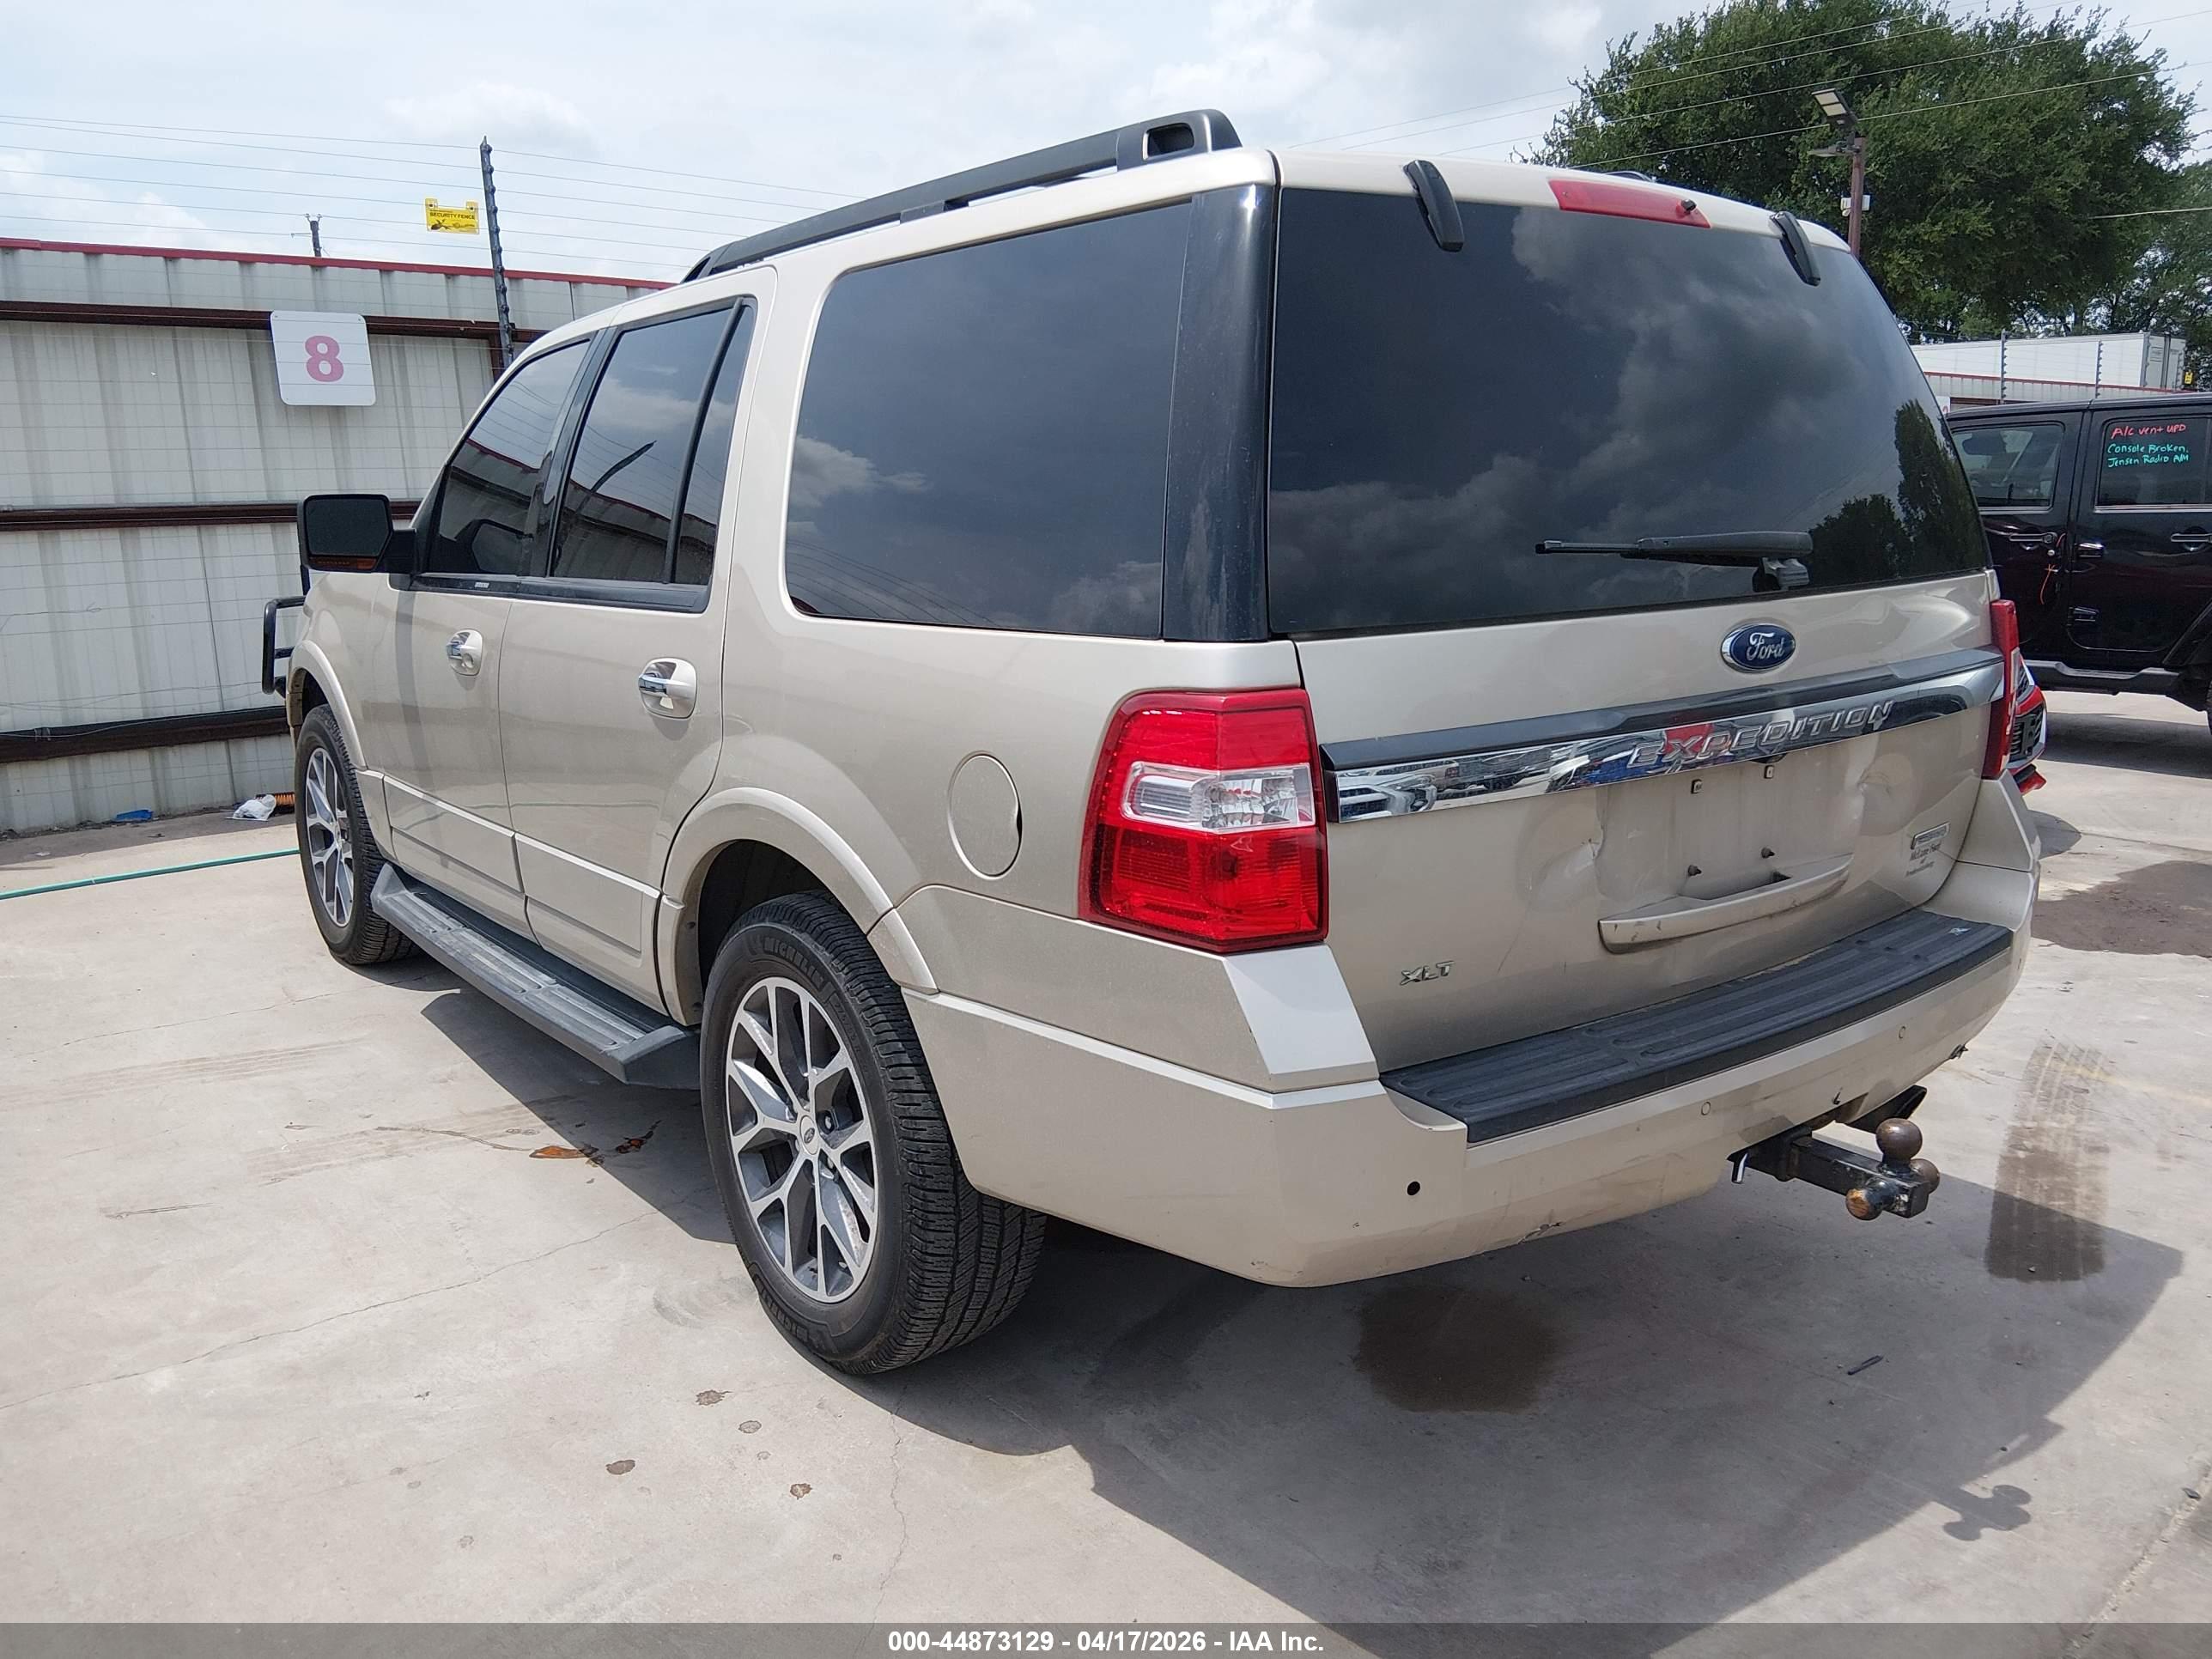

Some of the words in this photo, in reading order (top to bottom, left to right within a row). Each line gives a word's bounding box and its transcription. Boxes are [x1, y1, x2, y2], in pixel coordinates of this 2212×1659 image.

[305, 335, 344, 383] 8
[2107, 443, 2145, 453] Console
[2107, 457, 2140, 468] Jensen
[2142, 454, 2170, 464] Radio
[1746, 632, 1786, 661] Ford
[1626, 699, 1896, 769] EXPEDITION
[763, 936, 825, 990] MICHELIN
[1399, 960, 1456, 986] XLT
